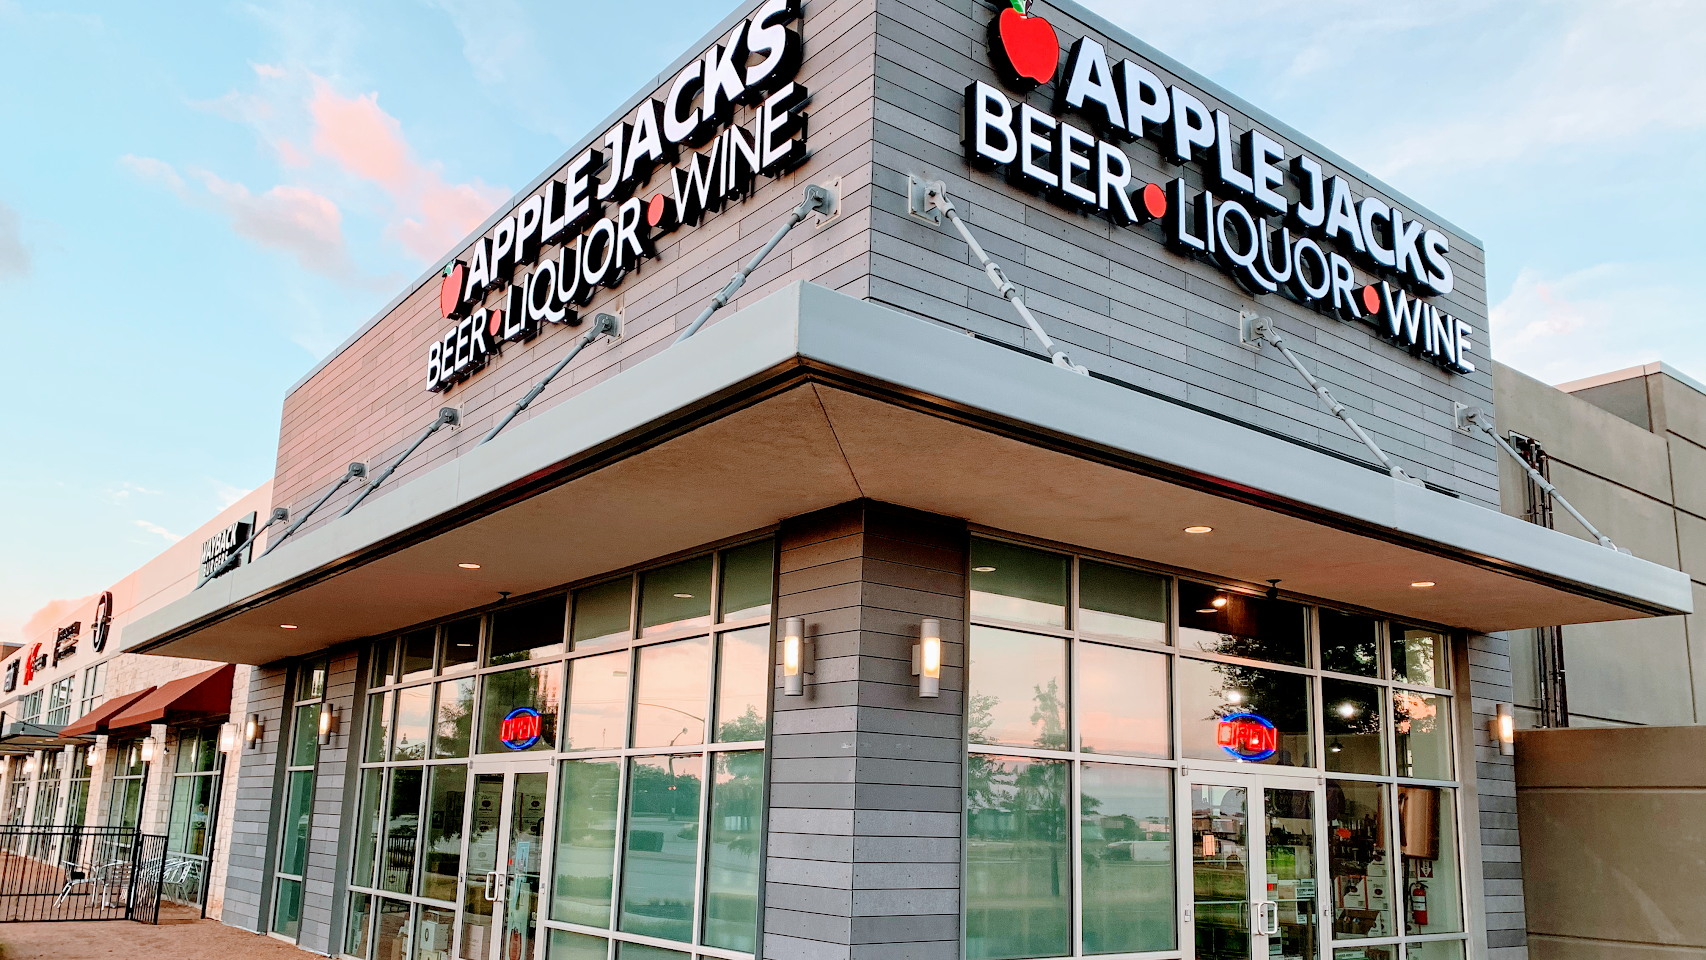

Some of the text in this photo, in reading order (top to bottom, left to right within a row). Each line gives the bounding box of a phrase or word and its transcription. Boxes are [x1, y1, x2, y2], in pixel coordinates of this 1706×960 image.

[426, 81, 795, 392] BEER LIQUOR WINE
[464, 0, 788, 303] APPLE JACKS
[976, 80, 1475, 373] BEER LIQUOR WINE
[1066, 36, 1454, 295] APPLE JACKS
[501, 715, 541, 741] OPEN
[1217, 721, 1277, 751] OPEN
